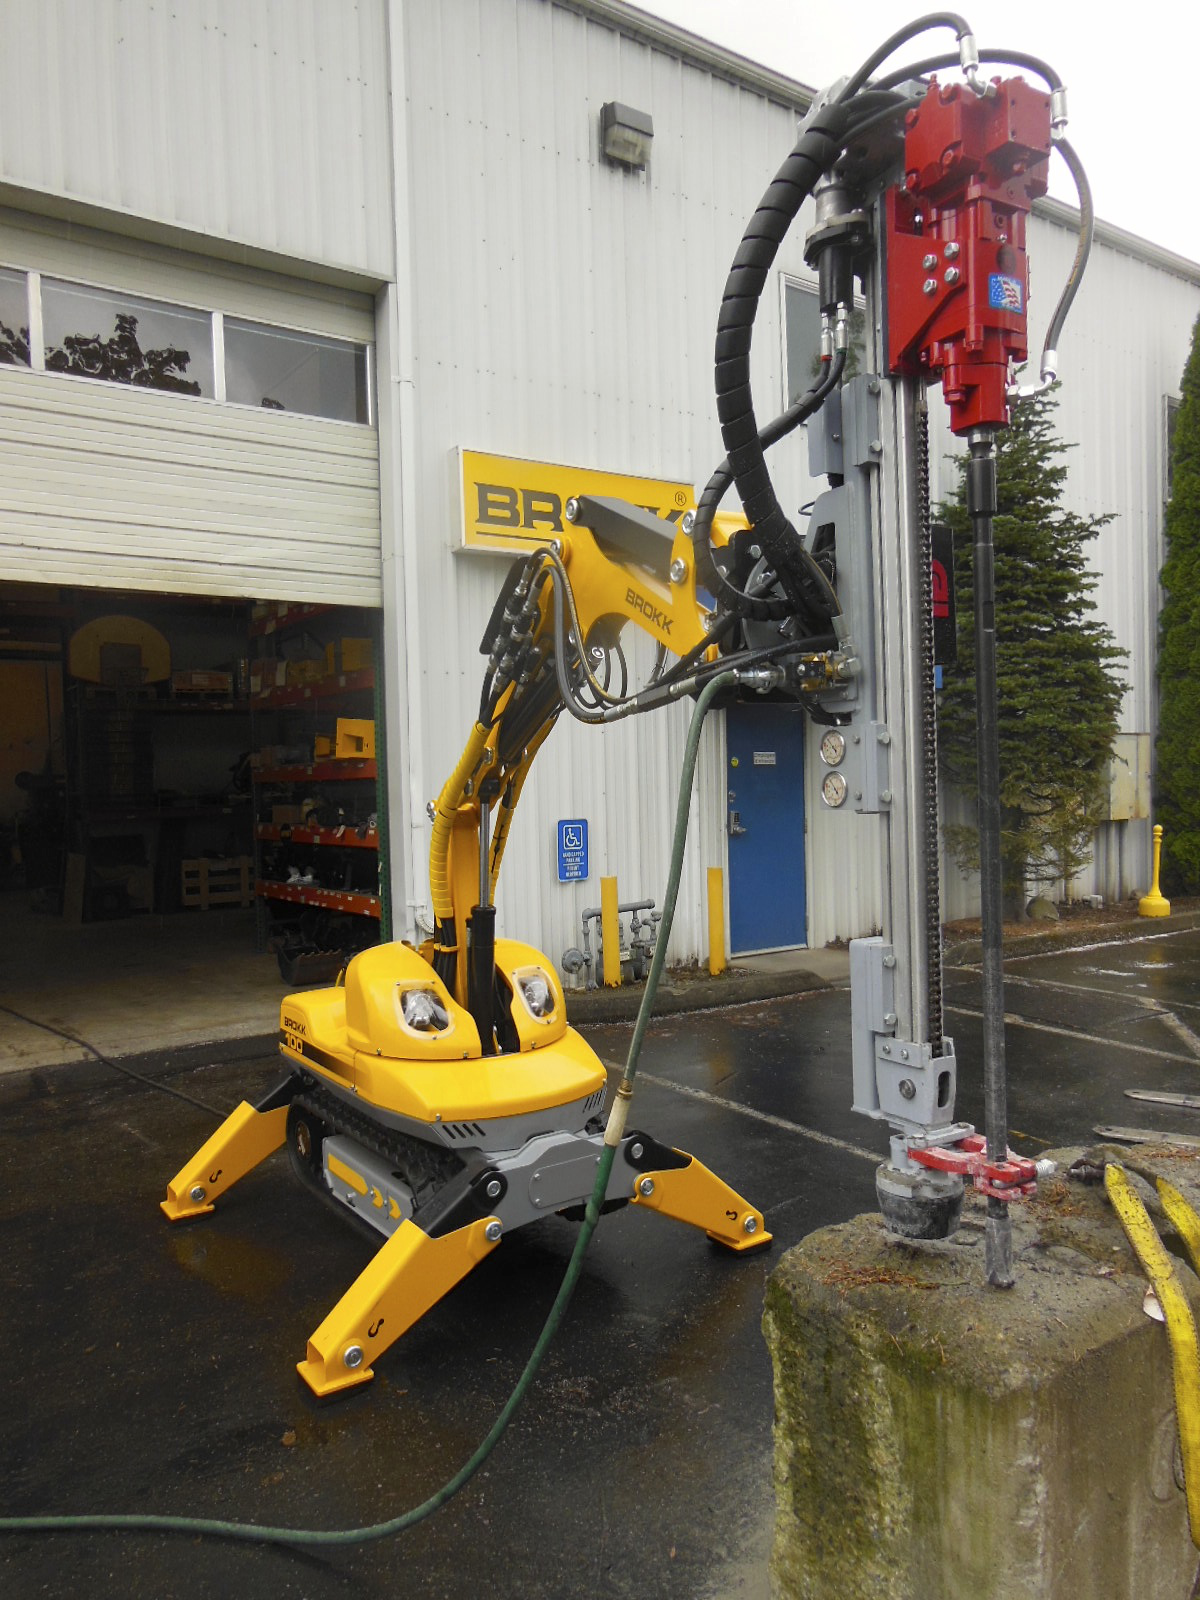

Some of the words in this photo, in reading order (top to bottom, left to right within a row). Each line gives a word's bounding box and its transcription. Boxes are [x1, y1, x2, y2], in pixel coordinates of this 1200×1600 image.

[625, 588, 674, 635] BROKK
[284, 1016, 306, 1035] BROKK
[285, 1032, 303, 1053] 100
